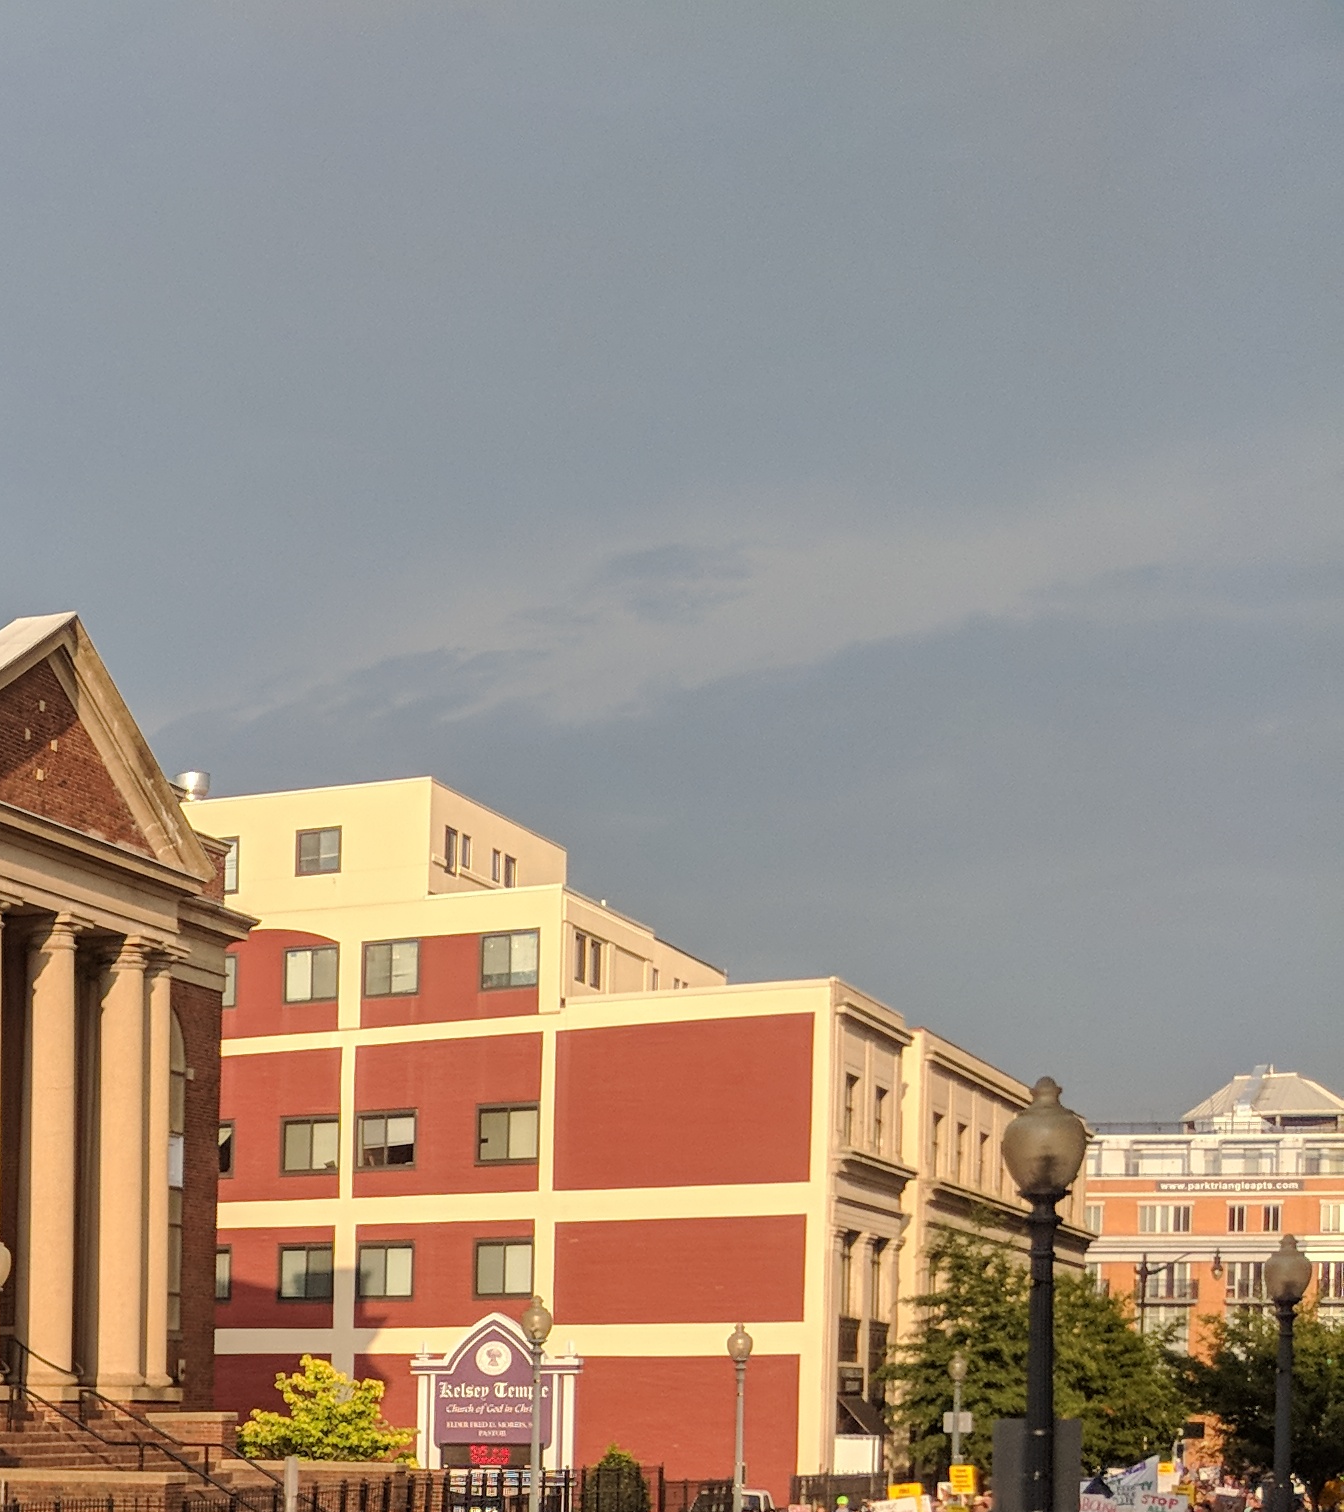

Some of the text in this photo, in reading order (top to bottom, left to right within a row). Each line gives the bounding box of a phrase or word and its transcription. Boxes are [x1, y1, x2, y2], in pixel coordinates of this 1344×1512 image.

[1159, 1180, 1300, 1192] www.parktriangleapts.com
[438, 1381, 550, 1401] Kelsey Tempe
[446, 1403, 475, 1413] Church
[475, 1402, 487, 1415] of
[487, 1403, 504, 1413] God
[504, 1404, 513, 1413] in
[1141, 1494, 1179, 1509] STOP
